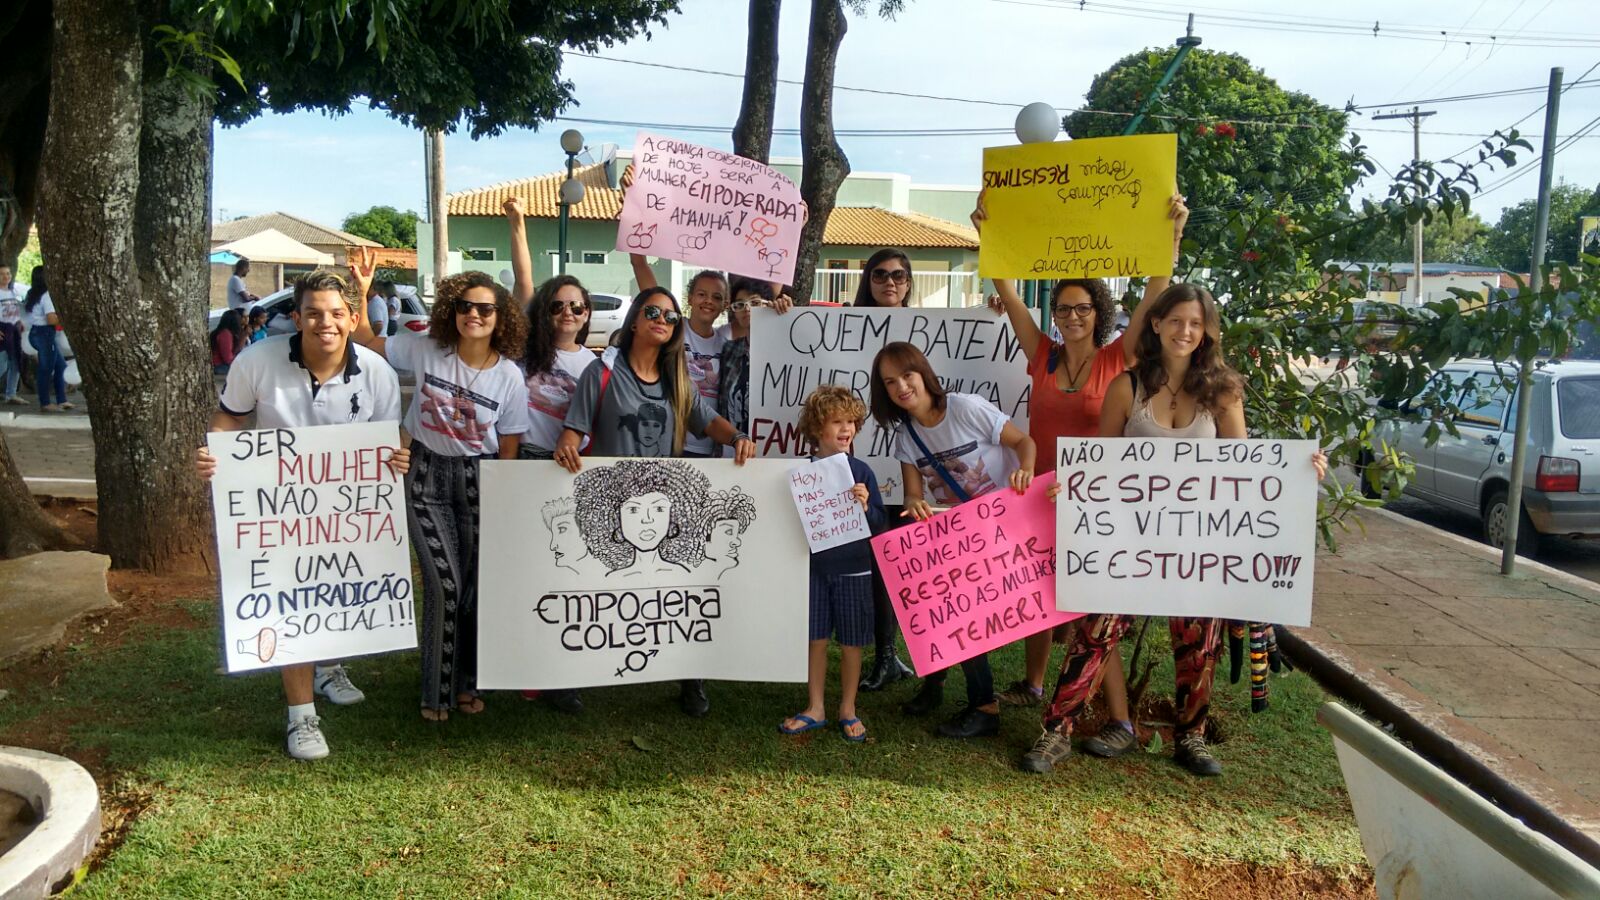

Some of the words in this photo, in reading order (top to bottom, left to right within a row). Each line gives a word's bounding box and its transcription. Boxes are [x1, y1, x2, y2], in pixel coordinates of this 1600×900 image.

[643, 137, 654, 150] A
[657, 140, 703, 159] CRIANÇA
[643, 153, 659, 164] DE
[669, 159, 709, 179] HOJE,
[772, 179, 781, 191] A
[639, 168, 687, 189] MULHER
[689, 180, 797, 222] EMPODERADA
[647, 194, 666, 210] DE
[1030, 257, 1142, 277] Machismo
[789, 310, 892, 358] QUEM
[908, 315, 994, 361] BATE
[232, 429, 296, 460] SER
[1061, 441, 1104, 467] NÃO
[1121, 442, 1155, 462] AO
[278, 446, 397, 486] MULHER
[229, 491, 245, 516] E
[258, 483, 317, 516] NÃO
[333, 484, 393, 513] SER
[799, 489, 825, 502] MAIS
[1067, 470, 1282, 503] RESPEITO
[236, 512, 403, 549] FEMINISTA,
[810, 514, 824, 528] DÊ
[832, 506, 854, 520] BOM
[812, 513, 863, 541] EXEMPLO!
[883, 512, 966, 563] ENSINE
[977, 497, 1006, 520] OS
[1074, 506, 1115, 536] ÀS
[1135, 506, 1280, 538] VÍTIMAS
[251, 551, 271, 588] É
[295, 551, 363, 583] UMA
[897, 533, 986, 580] HOMENS
[994, 525, 1007, 545] A
[1067, 550, 1099, 576] DE
[1108, 550, 1301, 589] ESTUPRO!!!
[899, 536, 1054, 610] RESPEITAR,
[236, 573, 410, 620] CONTRADIÇÃO
[910, 613, 926, 635] E
[929, 592, 971, 628] NÃO
[976, 582, 999, 606] AS
[284, 600, 413, 638] SOCIAL!!!
[930, 642, 943, 662] A
[948, 591, 1048, 651] TEMER!
